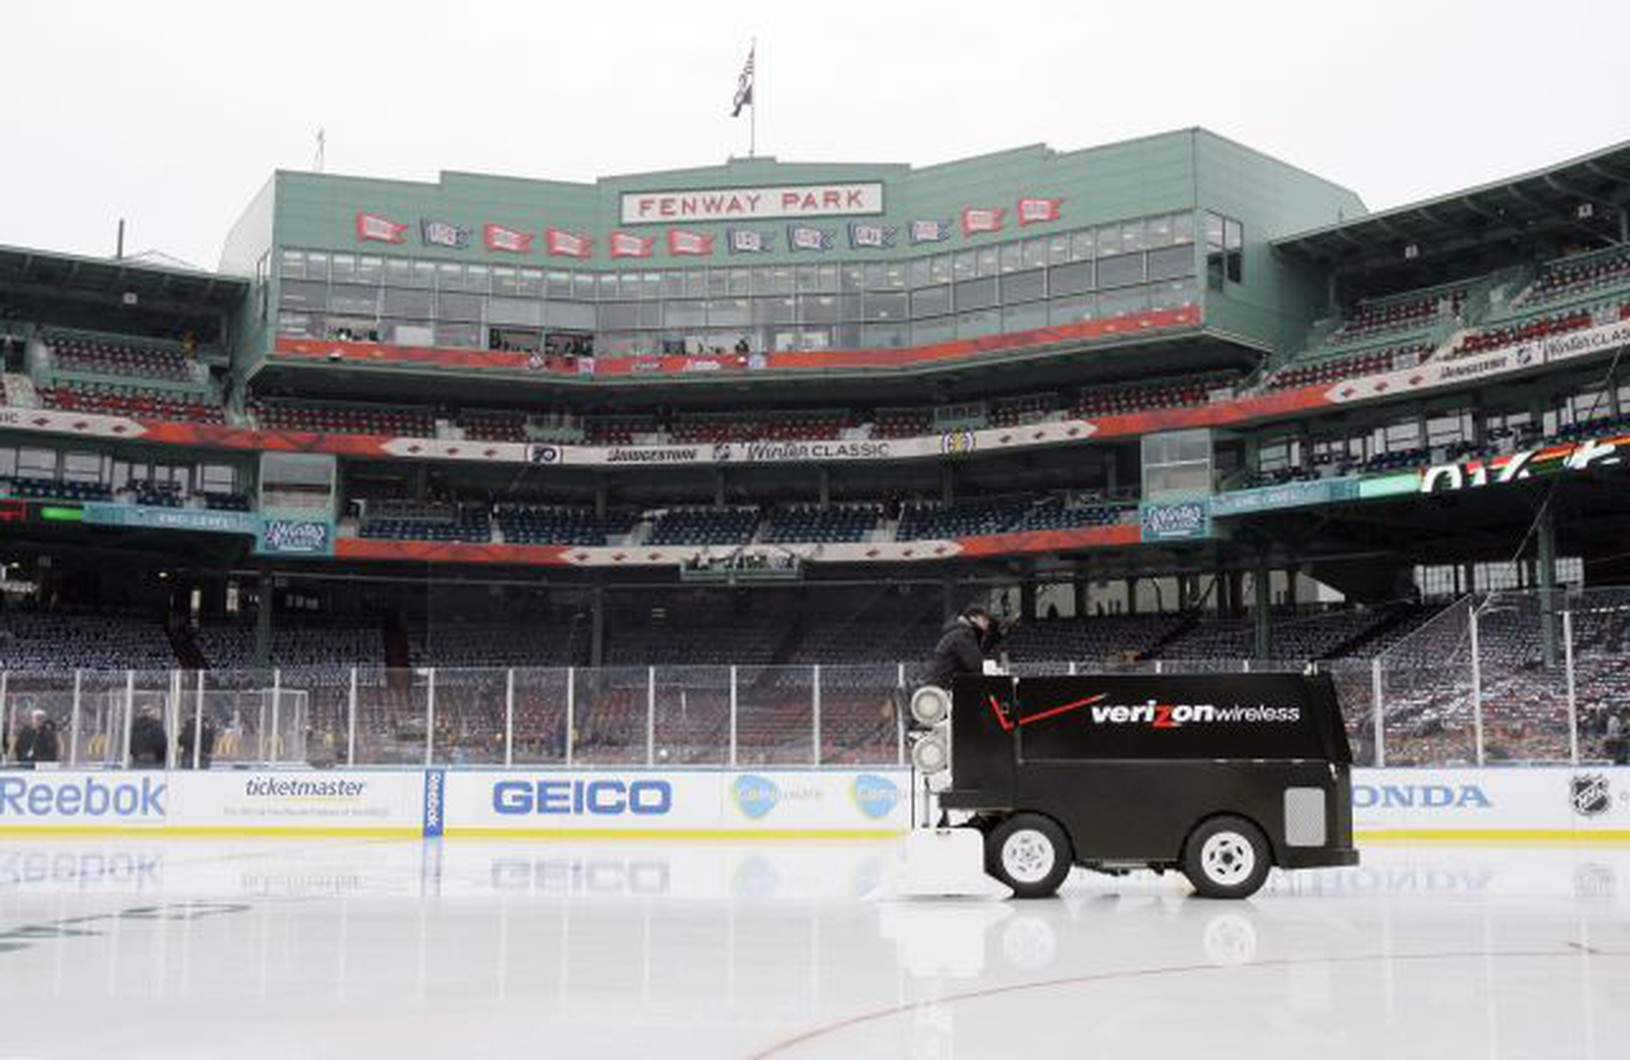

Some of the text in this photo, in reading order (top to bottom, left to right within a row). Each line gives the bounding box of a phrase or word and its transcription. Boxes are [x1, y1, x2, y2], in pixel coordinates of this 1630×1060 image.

[638, 188, 864, 217] FENWAY PARK
[811, 442, 891, 457] CLASSIC
[0, 776, 167, 817] Reebok
[245, 776, 366, 796] ticketmaster
[427, 772, 441, 827] Reebok
[493, 780, 672, 815] GEICO
[1352, 783, 1493, 808] ONDA
